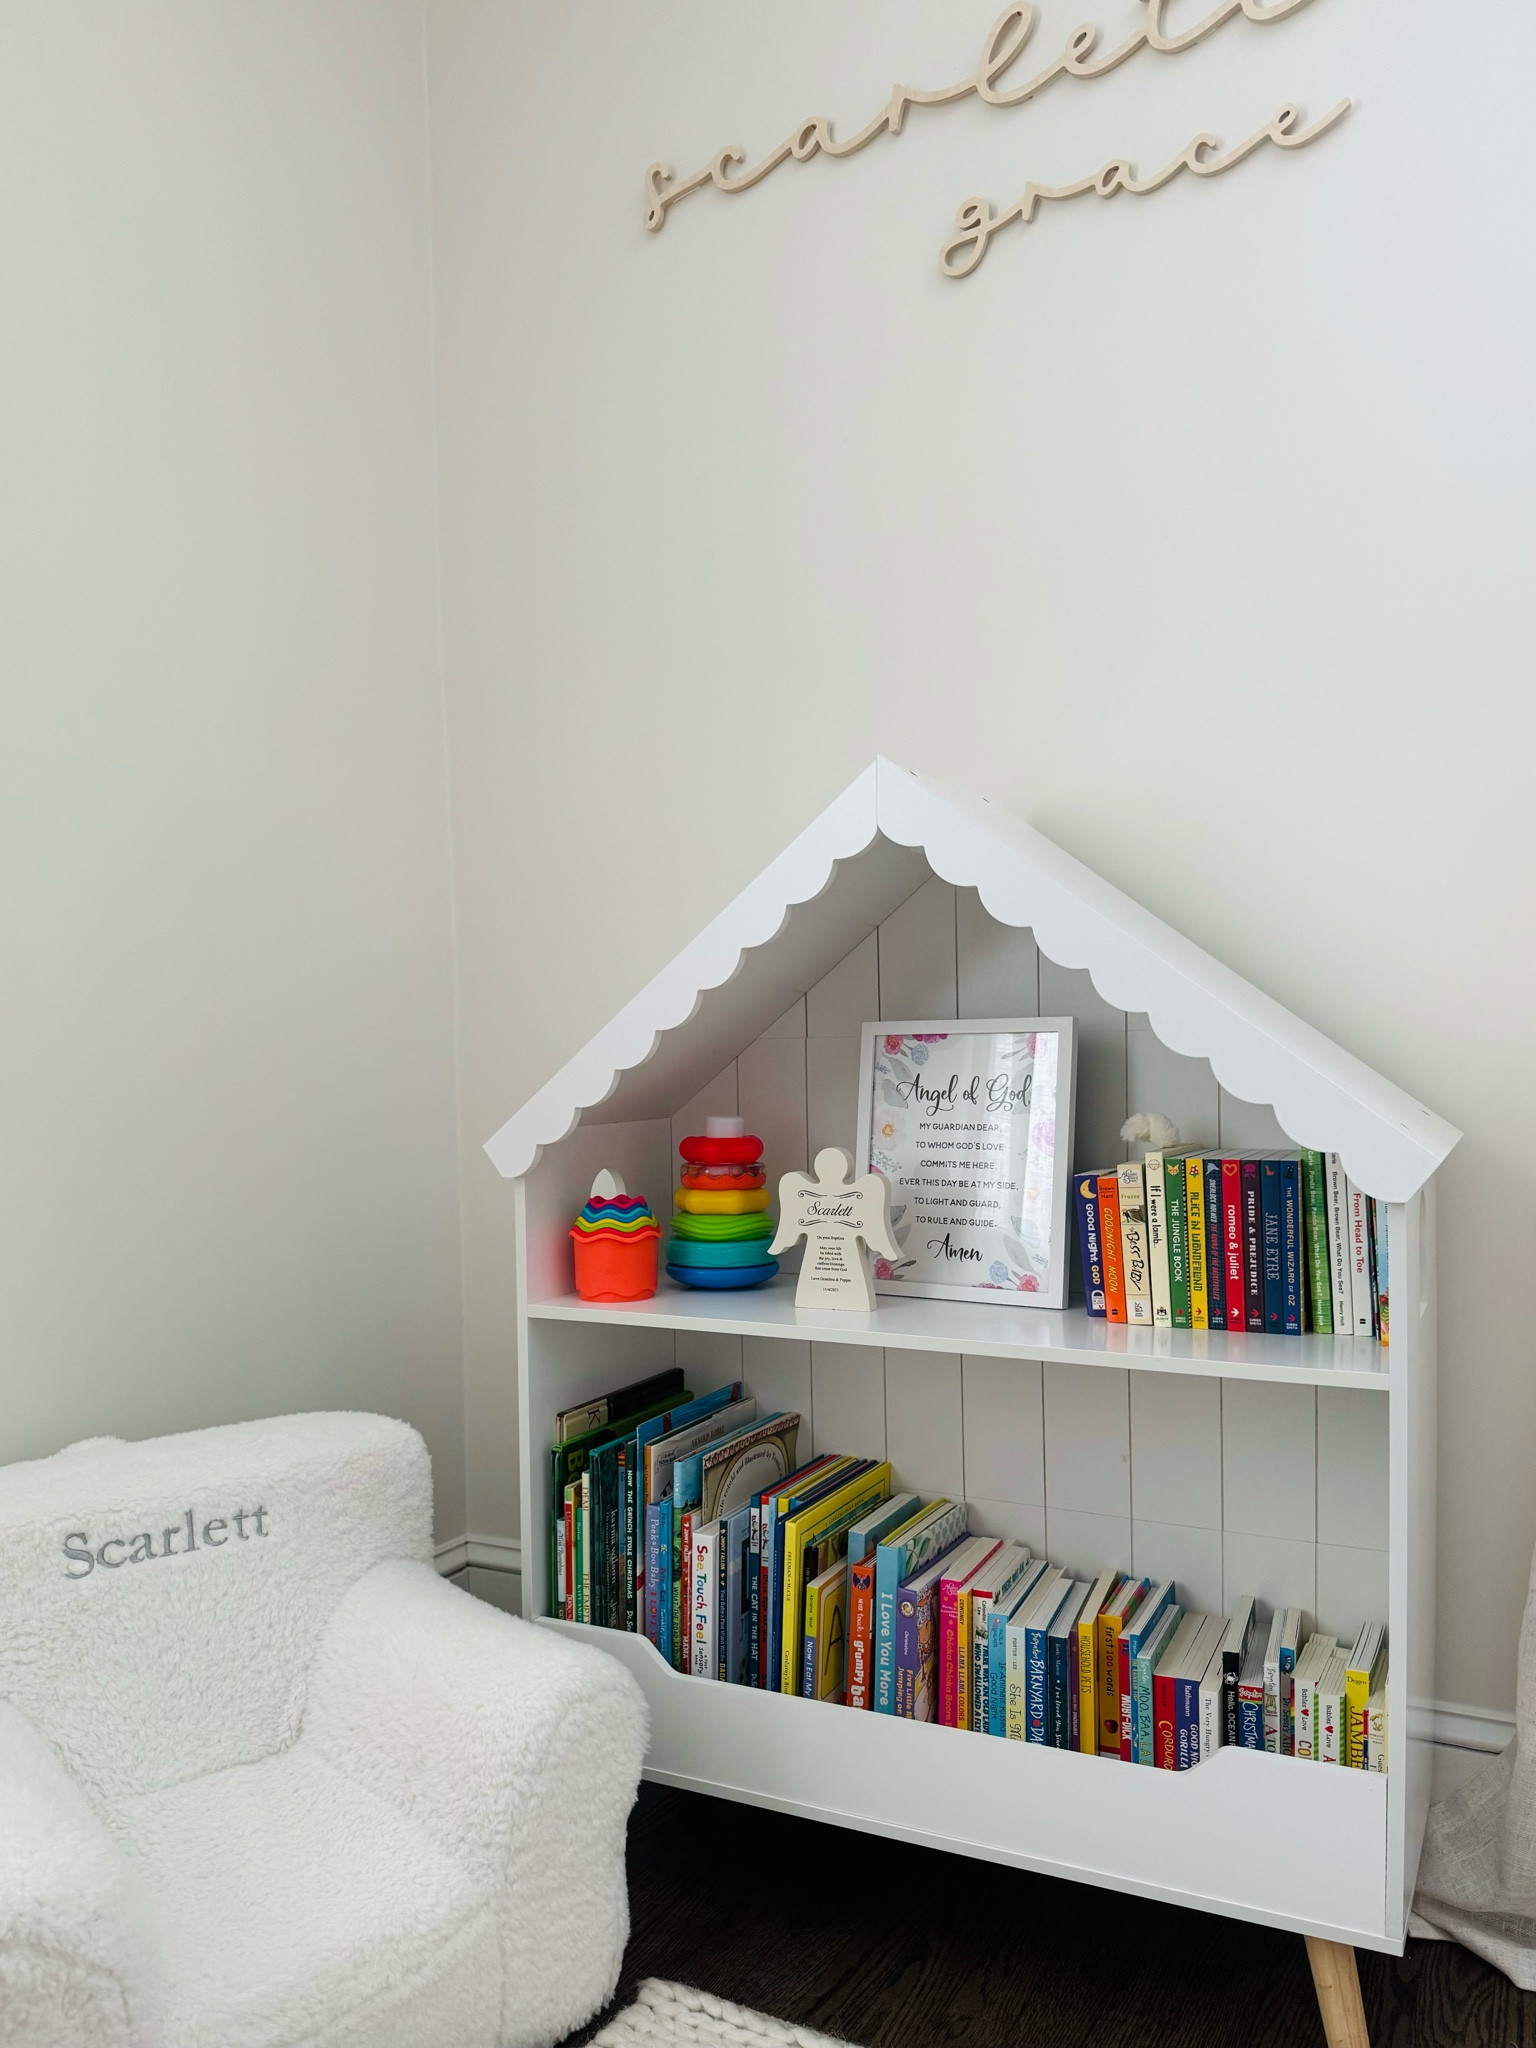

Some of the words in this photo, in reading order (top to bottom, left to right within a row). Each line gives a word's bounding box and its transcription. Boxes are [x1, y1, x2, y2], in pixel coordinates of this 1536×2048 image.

[939, 97, 1353, 280] grace
[896, 1073, 958, 1117] Angel
[962, 1075, 980, 1105] of
[919, 1122, 932, 1131] MY
[932, 1123, 976, 1132] GUARDIAN
[915, 1141, 926, 1149] TO
[927, 1141, 955, 1150] WHOM
[955, 1141, 981, 1151] GOD'S
[982, 1143, 1005, 1152] LOVE
[920, 1159, 958, 1169] COMMITS
[958, 1161, 971, 1169] ME
[899, 1177, 921, 1187] EVER
[921, 1178, 940, 1187] THIS
[941, 1179, 960, 1188] DAY
[958, 1180, 969, 1188] BE
[970, 1180, 982, 1189] AT
[982, 1181, 997, 1189] MY
[996, 1181, 1019, 1191] SIDE,
[807, 1200, 854, 1217] Scarlett
[914, 1196, 925, 1205] TO
[925, 1197, 949, 1206] LIGHT
[949, 1198, 968, 1207] AND
[1151, 1199, 1159, 1216] were
[1170, 1199, 1179, 1217] THE
[1247, 1190, 1256, 1223] PRIDE
[1353, 1192, 1362, 1218] From
[915, 1215, 926, 1224] TO
[928, 1216, 948, 1225] RULE
[949, 1218, 968, 1226] AND
[1227, 1204, 1237, 1240] romeo
[1248, 1226, 1256, 1235] &
[1265, 1212, 1279, 1244] JANE
[1286, 1200, 1295, 1250] WONDERFUL
[1354, 1219, 1363, 1244] Head
[1103, 1207, 1117, 1261] GOODNIGHT
[1171, 1218, 1181, 1254] JUNGLE
[926, 1232, 984, 1263] Amen
[1228, 1242, 1239, 1251] &
[1355, 1246, 1363, 1254] to
[1173, 1255, 1183, 1282] BOOK
[1227, 1251, 1240, 1281] juliet
[1249, 1237, 1259, 1296] PREJUDICE
[1265, 1247, 1280, 1282] EYRE
[1287, 1251, 1296, 1285] WIZARD
[1336, 1258, 1343, 1267] Do
[1356, 1255, 1365, 1273] Toe
[1107, 1265, 1119, 1294] MOON
[1287, 1294, 1296, 1306] OZ
[62, 1505, 269, 1580] Scarlett
[648, 1566, 660, 1590] Baby
[751, 1593, 759, 1611] CAT
[881, 1592, 893, 1600] I
[696, 1614, 707, 1644] Feel
[752, 1613, 758, 1622] IN
[880, 1604, 893, 1637] Love
[946, 1629, 954, 1660] Chicka
[1105, 1627, 1115, 1648] first
[697, 1647, 705, 1675] sensory
[751, 1643, 759, 1661] HAT
[806, 1640, 814, 1660] Now
[880, 1641, 892, 1665] You
[974, 1643, 982, 1662] WHO
[1080, 1635, 1091, 1673] HOUSEHOLD
[1106, 1650, 1114, 1667] 100
[805, 1666, 813, 1681] Eat
[853, 1640, 865, 1684] grumpy
[879, 1669, 892, 1706] More
[896, 1666, 905, 1702] Jumping
[906, 1669, 914, 1685] Five
[945, 1661, 954, 1693] Chicka
[974, 1664, 982, 1709] SWALLOWED
[1028, 1658, 1045, 1719] BARNYARD
[1080, 1675, 1092, 1694] PETS
[1105, 1669, 1115, 1696] words
[1347, 1676, 1367, 1686] Degen
[803, 1682, 813, 1697] My
[1009, 1683, 1022, 1706] She
[897, 1704, 903, 1714] on
[945, 1694, 953, 1717] Boom
[1204, 1698, 1212, 1710] The
[1282, 1697, 1291, 1708] Dr.
[1009, 1709, 1021, 1720] Is
[1121, 1693, 1132, 1740] MOBY-DICK
[1203, 1712, 1212, 1728] Very
[1282, 1709, 1291, 1733] Seuss's
[1325, 1705, 1333, 1725] Babies
[1190, 1723, 1199, 1750] GOOD
[1227, 1712, 1236, 1743] OCEAN
[1265, 1724, 1278, 1736] A
[1140, 1741, 1152, 1757] LA
[1179, 1728, 1188, 1768] GORILLA
[1203, 1728, 1212, 1753] Hungry
[1267, 1737, 1276, 1753] TO
[1325, 1734, 1333, 1748] Love
